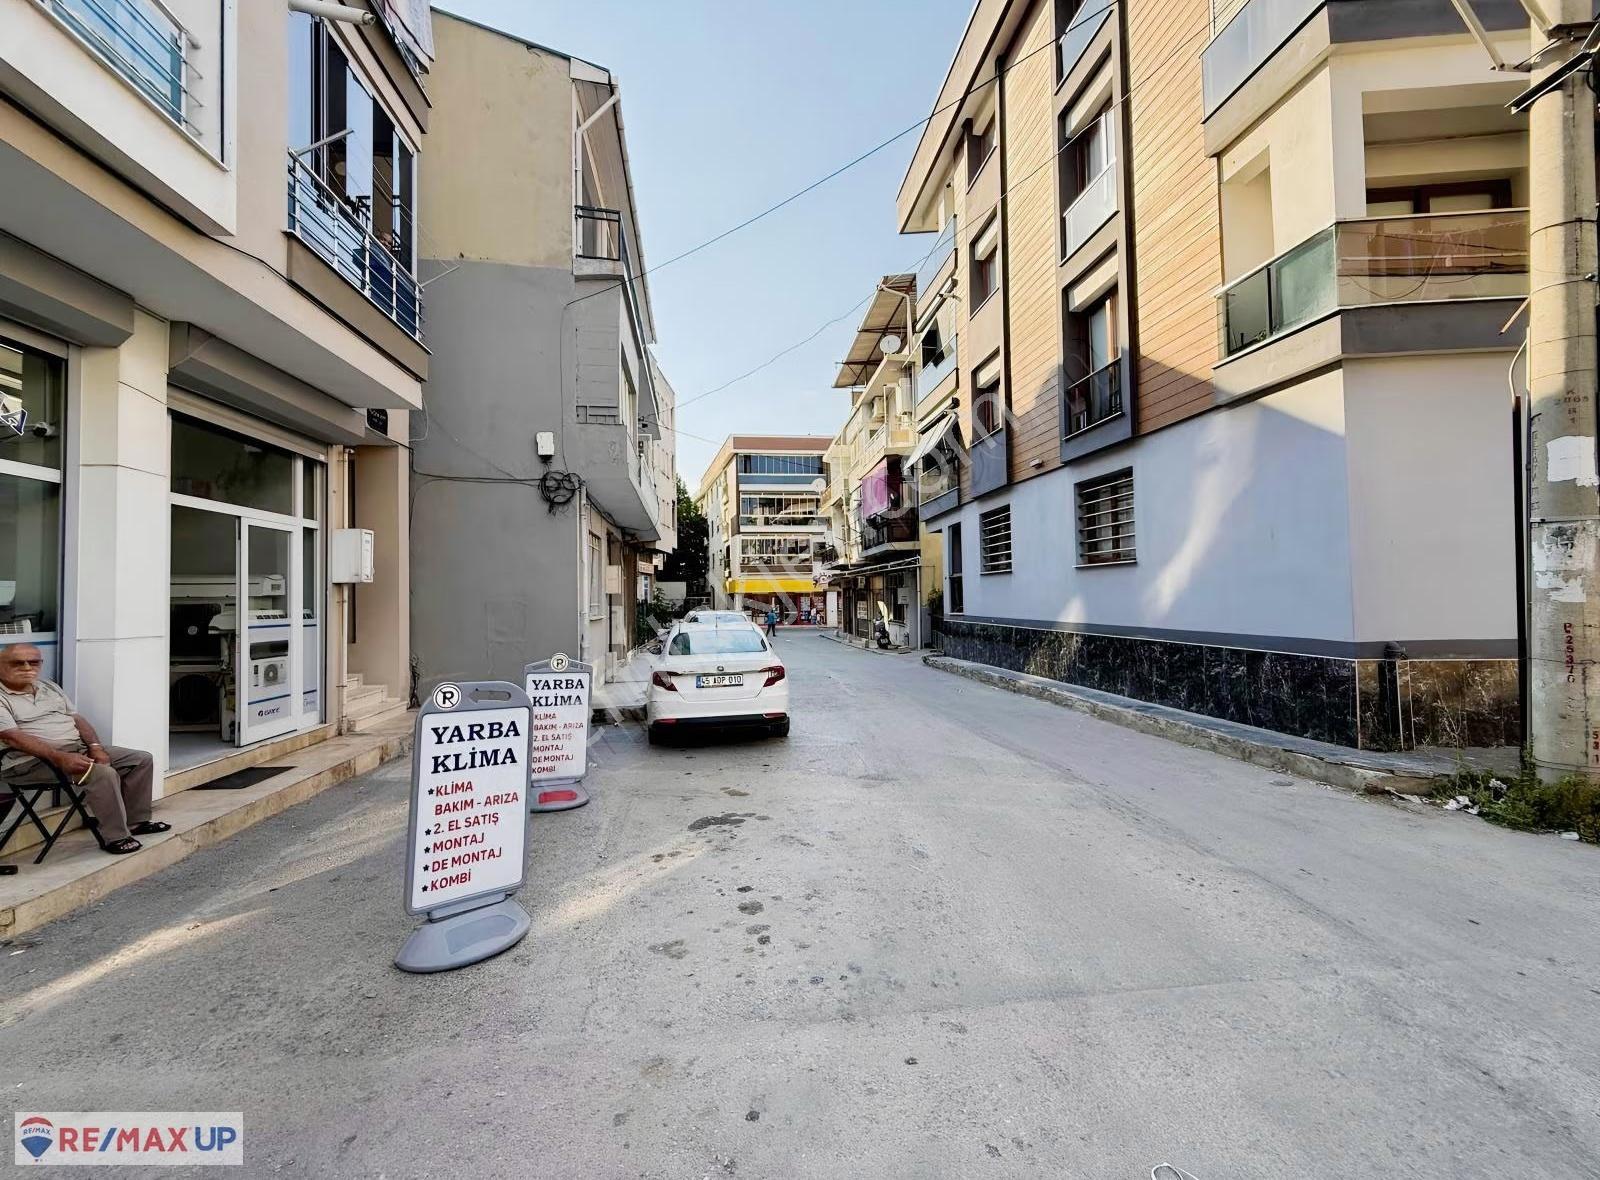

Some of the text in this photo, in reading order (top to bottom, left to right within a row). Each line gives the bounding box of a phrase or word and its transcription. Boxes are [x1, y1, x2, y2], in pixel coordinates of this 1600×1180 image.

[532, 679, 584, 690] YARBA
[532, 694, 583, 707] KLİMA
[431, 720, 520, 745] YARBA
[533, 744, 564, 752] MONTAJ
[543, 754, 574, 762] MONTAJ
[431, 746, 517, 774] KLİMA
[435, 781, 473, 797] KLİMA
[434, 799, 474, 816] BAKIM
[484, 792, 519, 807] ARIZA
[433, 812, 499, 835] 2. EL SATIŞ
[432, 832, 485, 854] MONTAJ
[431, 847, 502, 873] DE MONTAJ
[430, 869, 472, 892] KOMBİ
